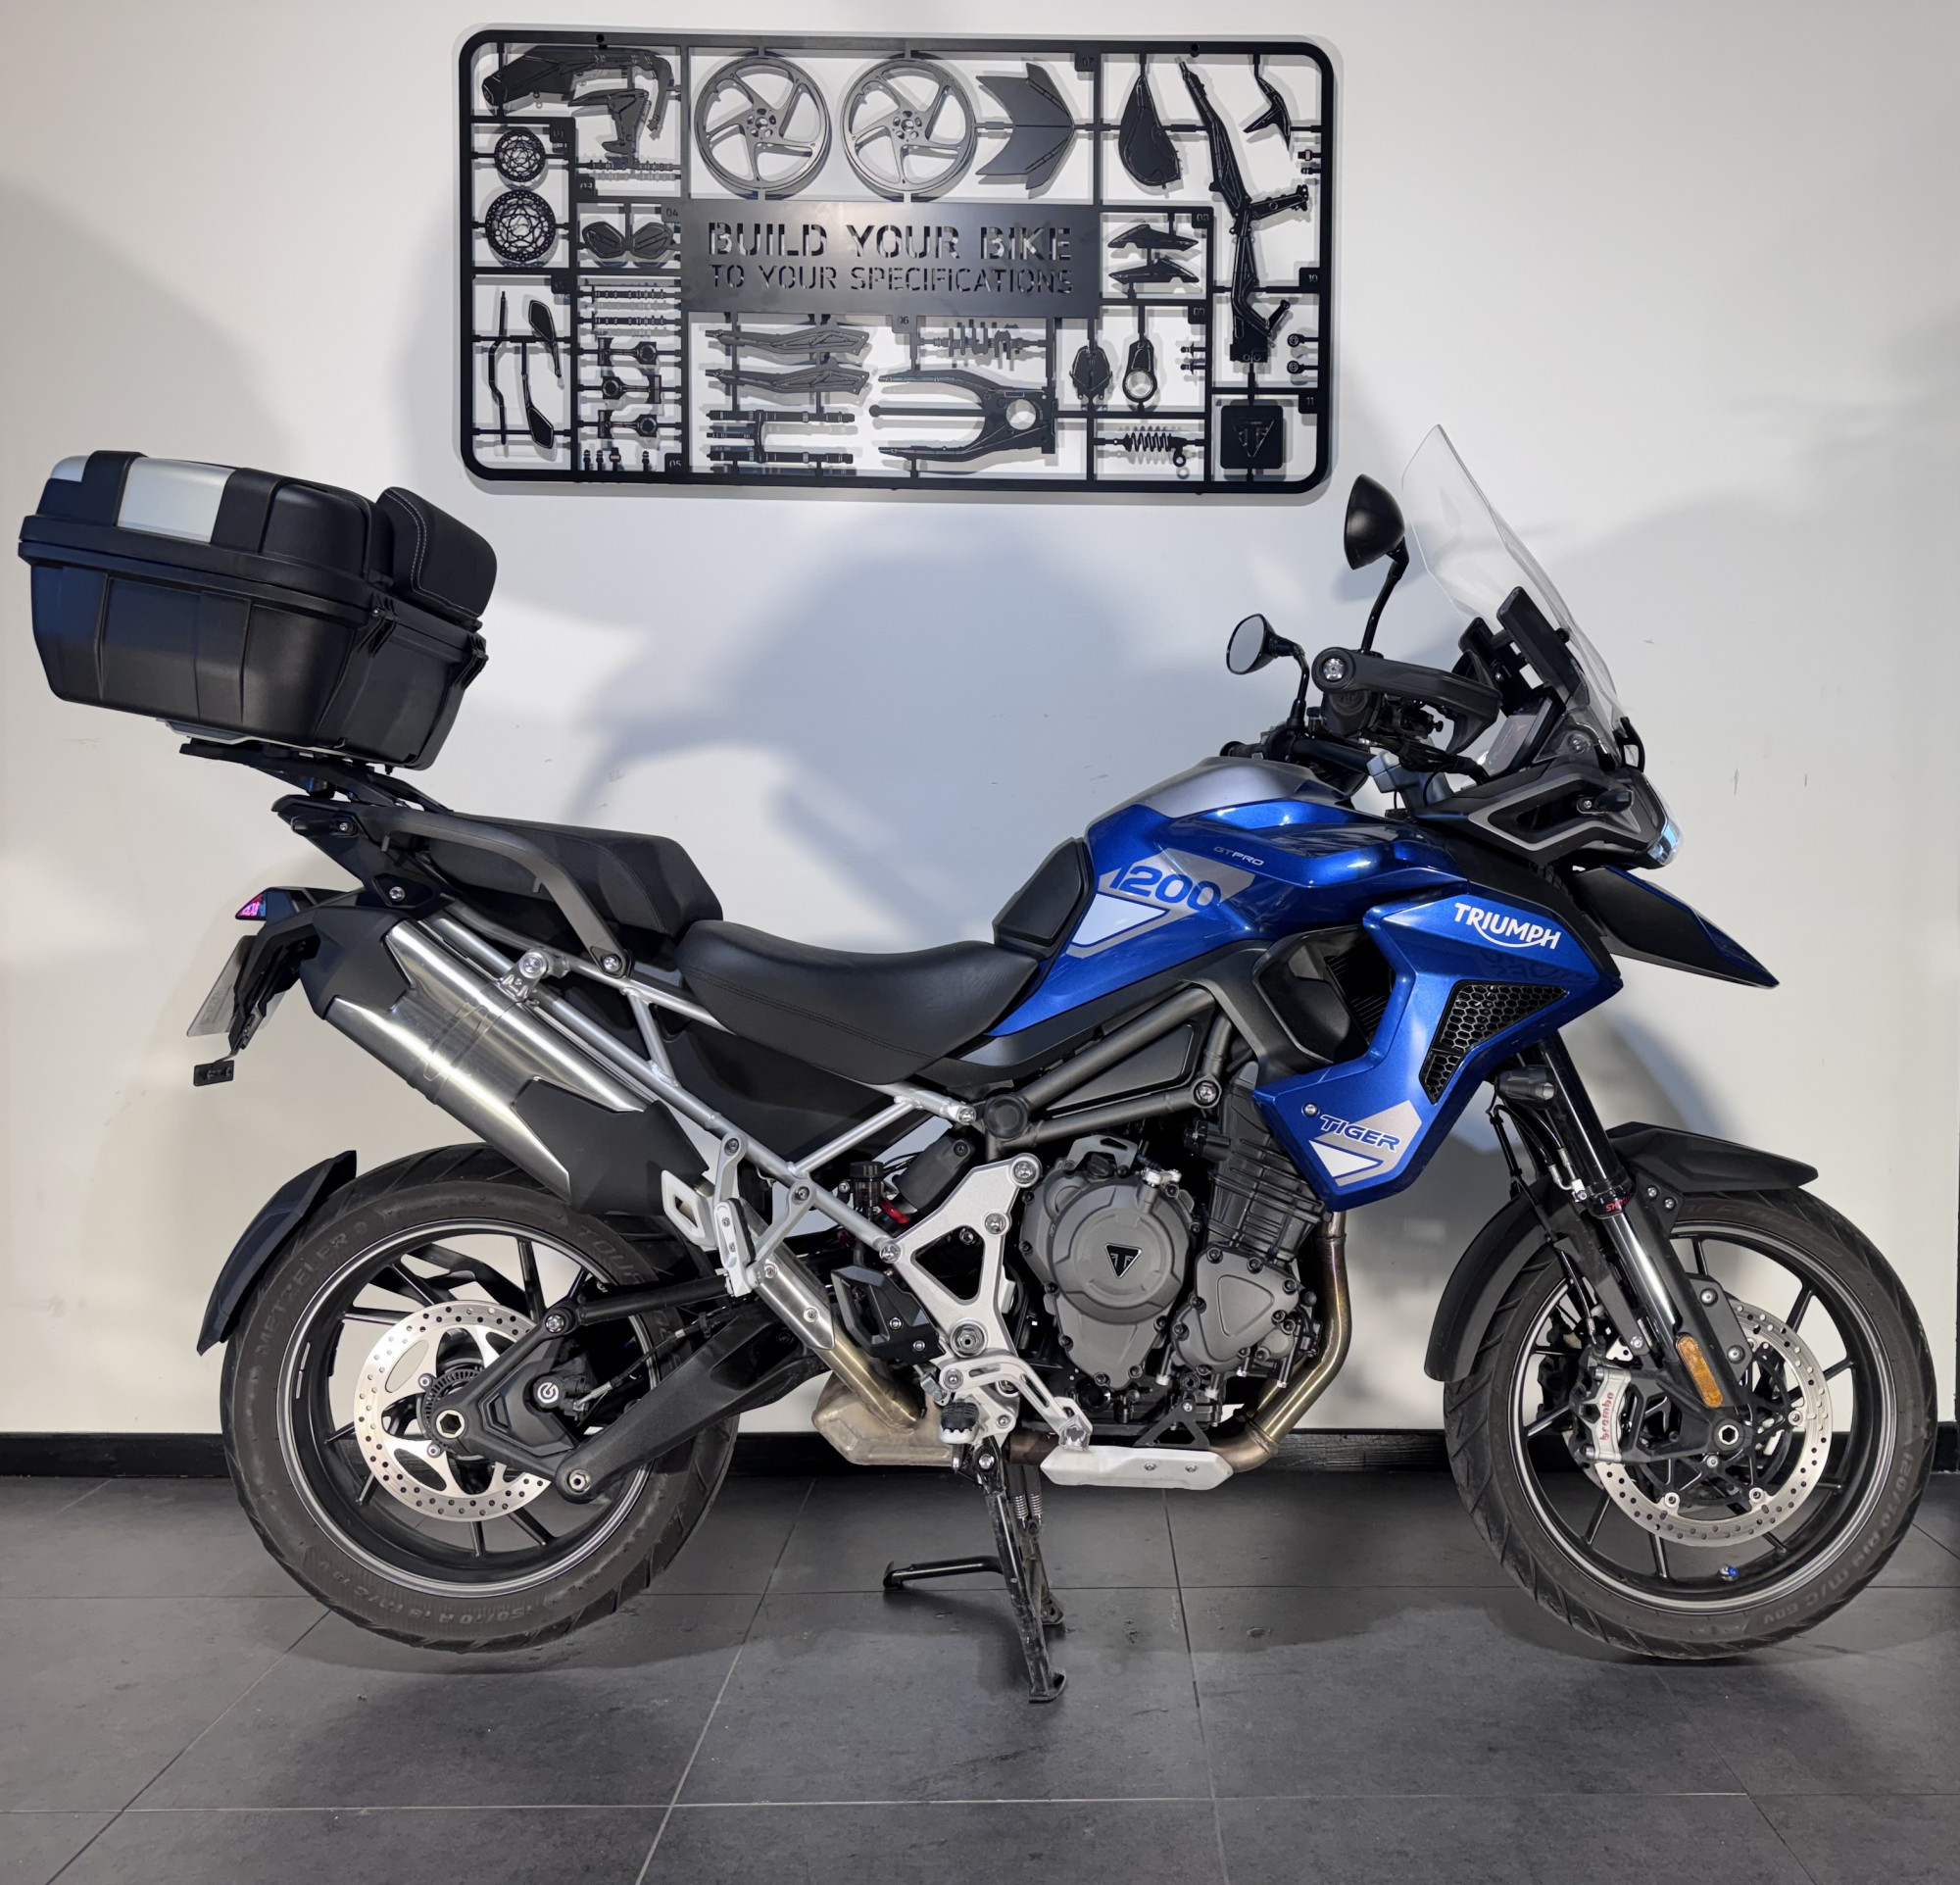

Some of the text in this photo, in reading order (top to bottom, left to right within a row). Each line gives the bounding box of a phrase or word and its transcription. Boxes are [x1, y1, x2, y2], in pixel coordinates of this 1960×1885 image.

[665, 208, 679, 218] 04
[709, 222, 1072, 261] BUILD YOUR BIKE
[709, 264, 1073, 294] TO YOUR SPECIFICATIONS
[1307, 273, 1318, 283] 10
[897, 316, 909, 325] 06
[1305, 397, 1314, 406] 11
[668, 459, 682, 469] 05
[1108, 861, 1222, 912] 1200
[1454, 902, 1562, 950] TRIUMPH
[1319, 1114, 1401, 1153] TIGER
[1599, 1392, 1615, 1441] brembo
